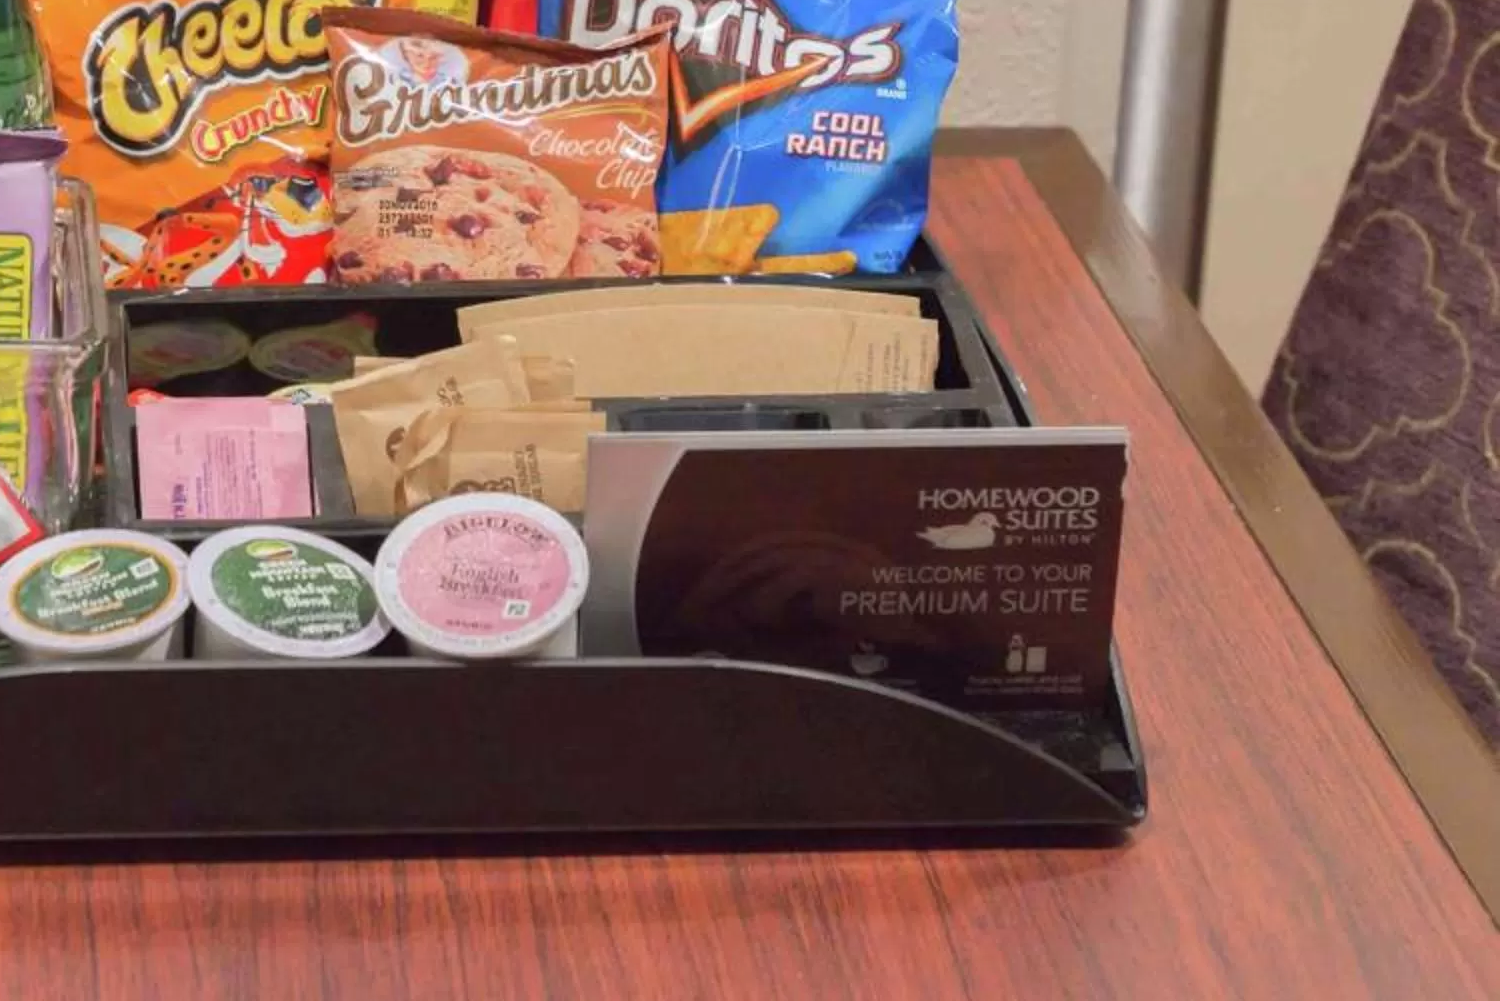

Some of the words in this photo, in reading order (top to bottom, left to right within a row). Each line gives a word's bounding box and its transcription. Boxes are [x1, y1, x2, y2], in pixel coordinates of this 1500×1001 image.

[335, 47, 657, 148] Grandma's
[191, 82, 328, 161] Crunchy
[811, 110, 885, 138] COOL
[785, 132, 886, 162] RANCH
[595, 158, 658, 201] Chip
[917, 486, 1100, 510] HOMEWOOD
[1005, 508, 1099, 531] SUITES
[1004, 534, 1023, 545] BY
[1031, 533, 1094, 545] HILTON
[871, 564, 986, 585] WELCOME
[993, 564, 1025, 583] TO
[1031, 563, 1093, 583] YOUR
[839, 589, 990, 616] PREMIUM
[999, 587, 1090, 614] SUITE
